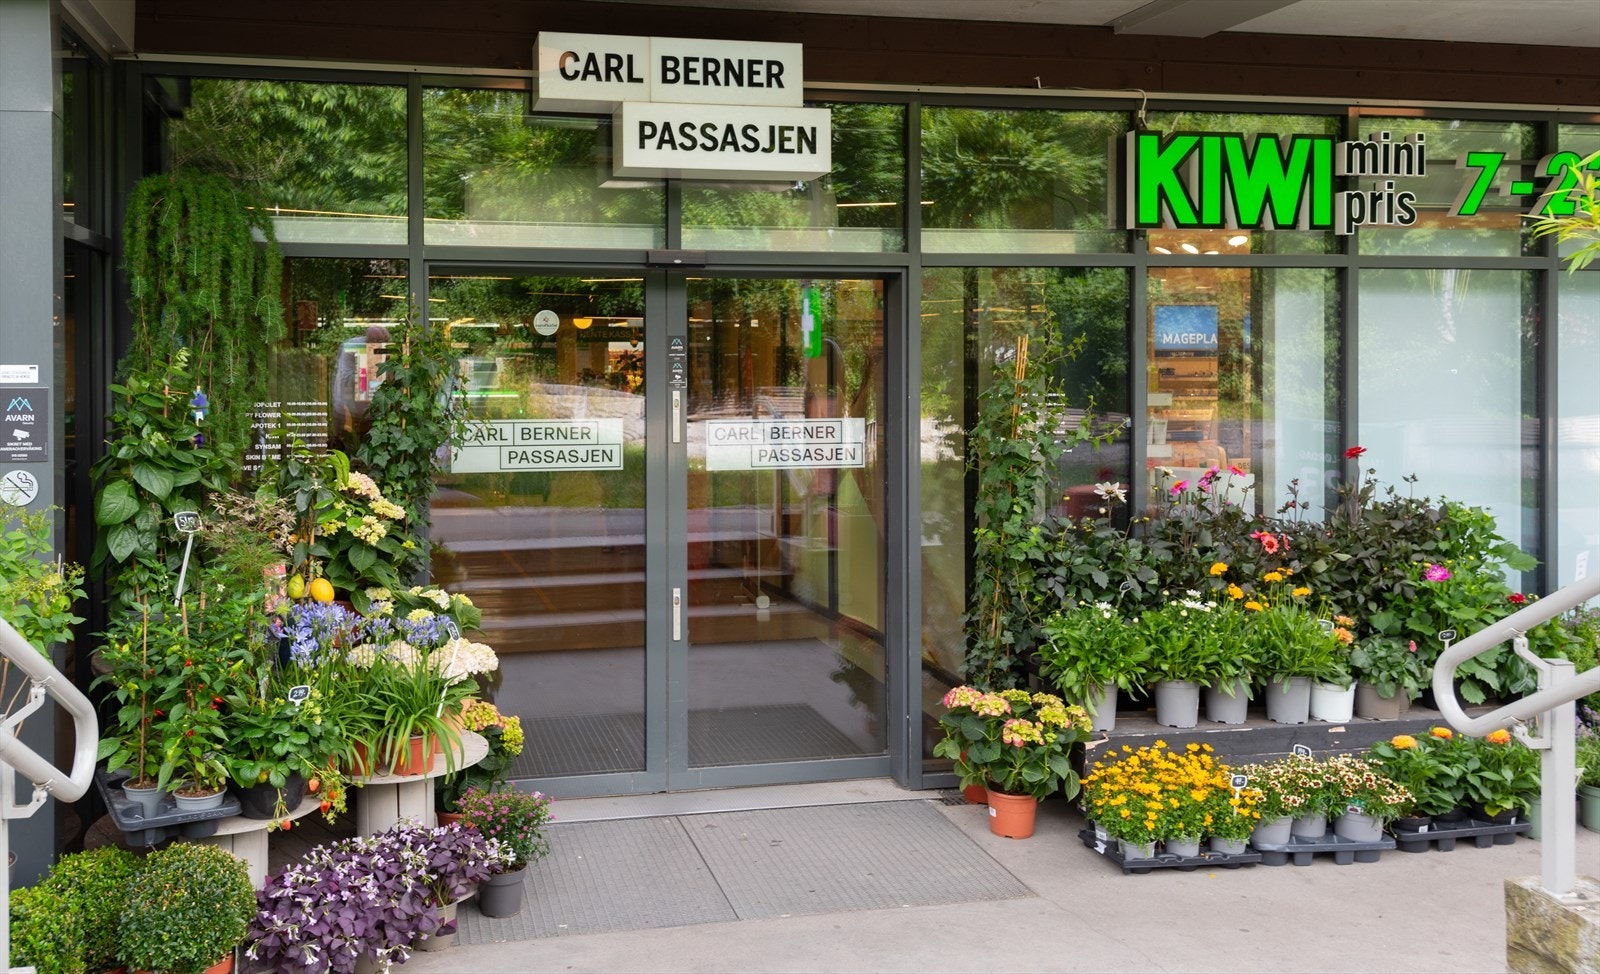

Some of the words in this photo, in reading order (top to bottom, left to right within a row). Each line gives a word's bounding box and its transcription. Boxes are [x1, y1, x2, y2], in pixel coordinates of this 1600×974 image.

[559, 51, 644, 83] CARL
[661, 55, 785, 88] BERNER
[638, 121, 817, 154] PASSASJEN
[1345, 131, 1426, 177] mini
[1135, 130, 1336, 230] KIWI
[1457, 151, 1506, 216] 7
[1345, 180, 1417, 236] pris
[1163, 333, 1218, 344] MAGEPLA
[5, 414, 35, 422] AVARN
[462, 427, 508, 442] CARL
[521, 427, 591, 441] BERNER
[714, 427, 758, 441] CARL
[770, 426, 836, 440] BERNER
[508, 449, 613, 464] PASSASJEN
[758, 447, 856, 462] PASSASJEN
